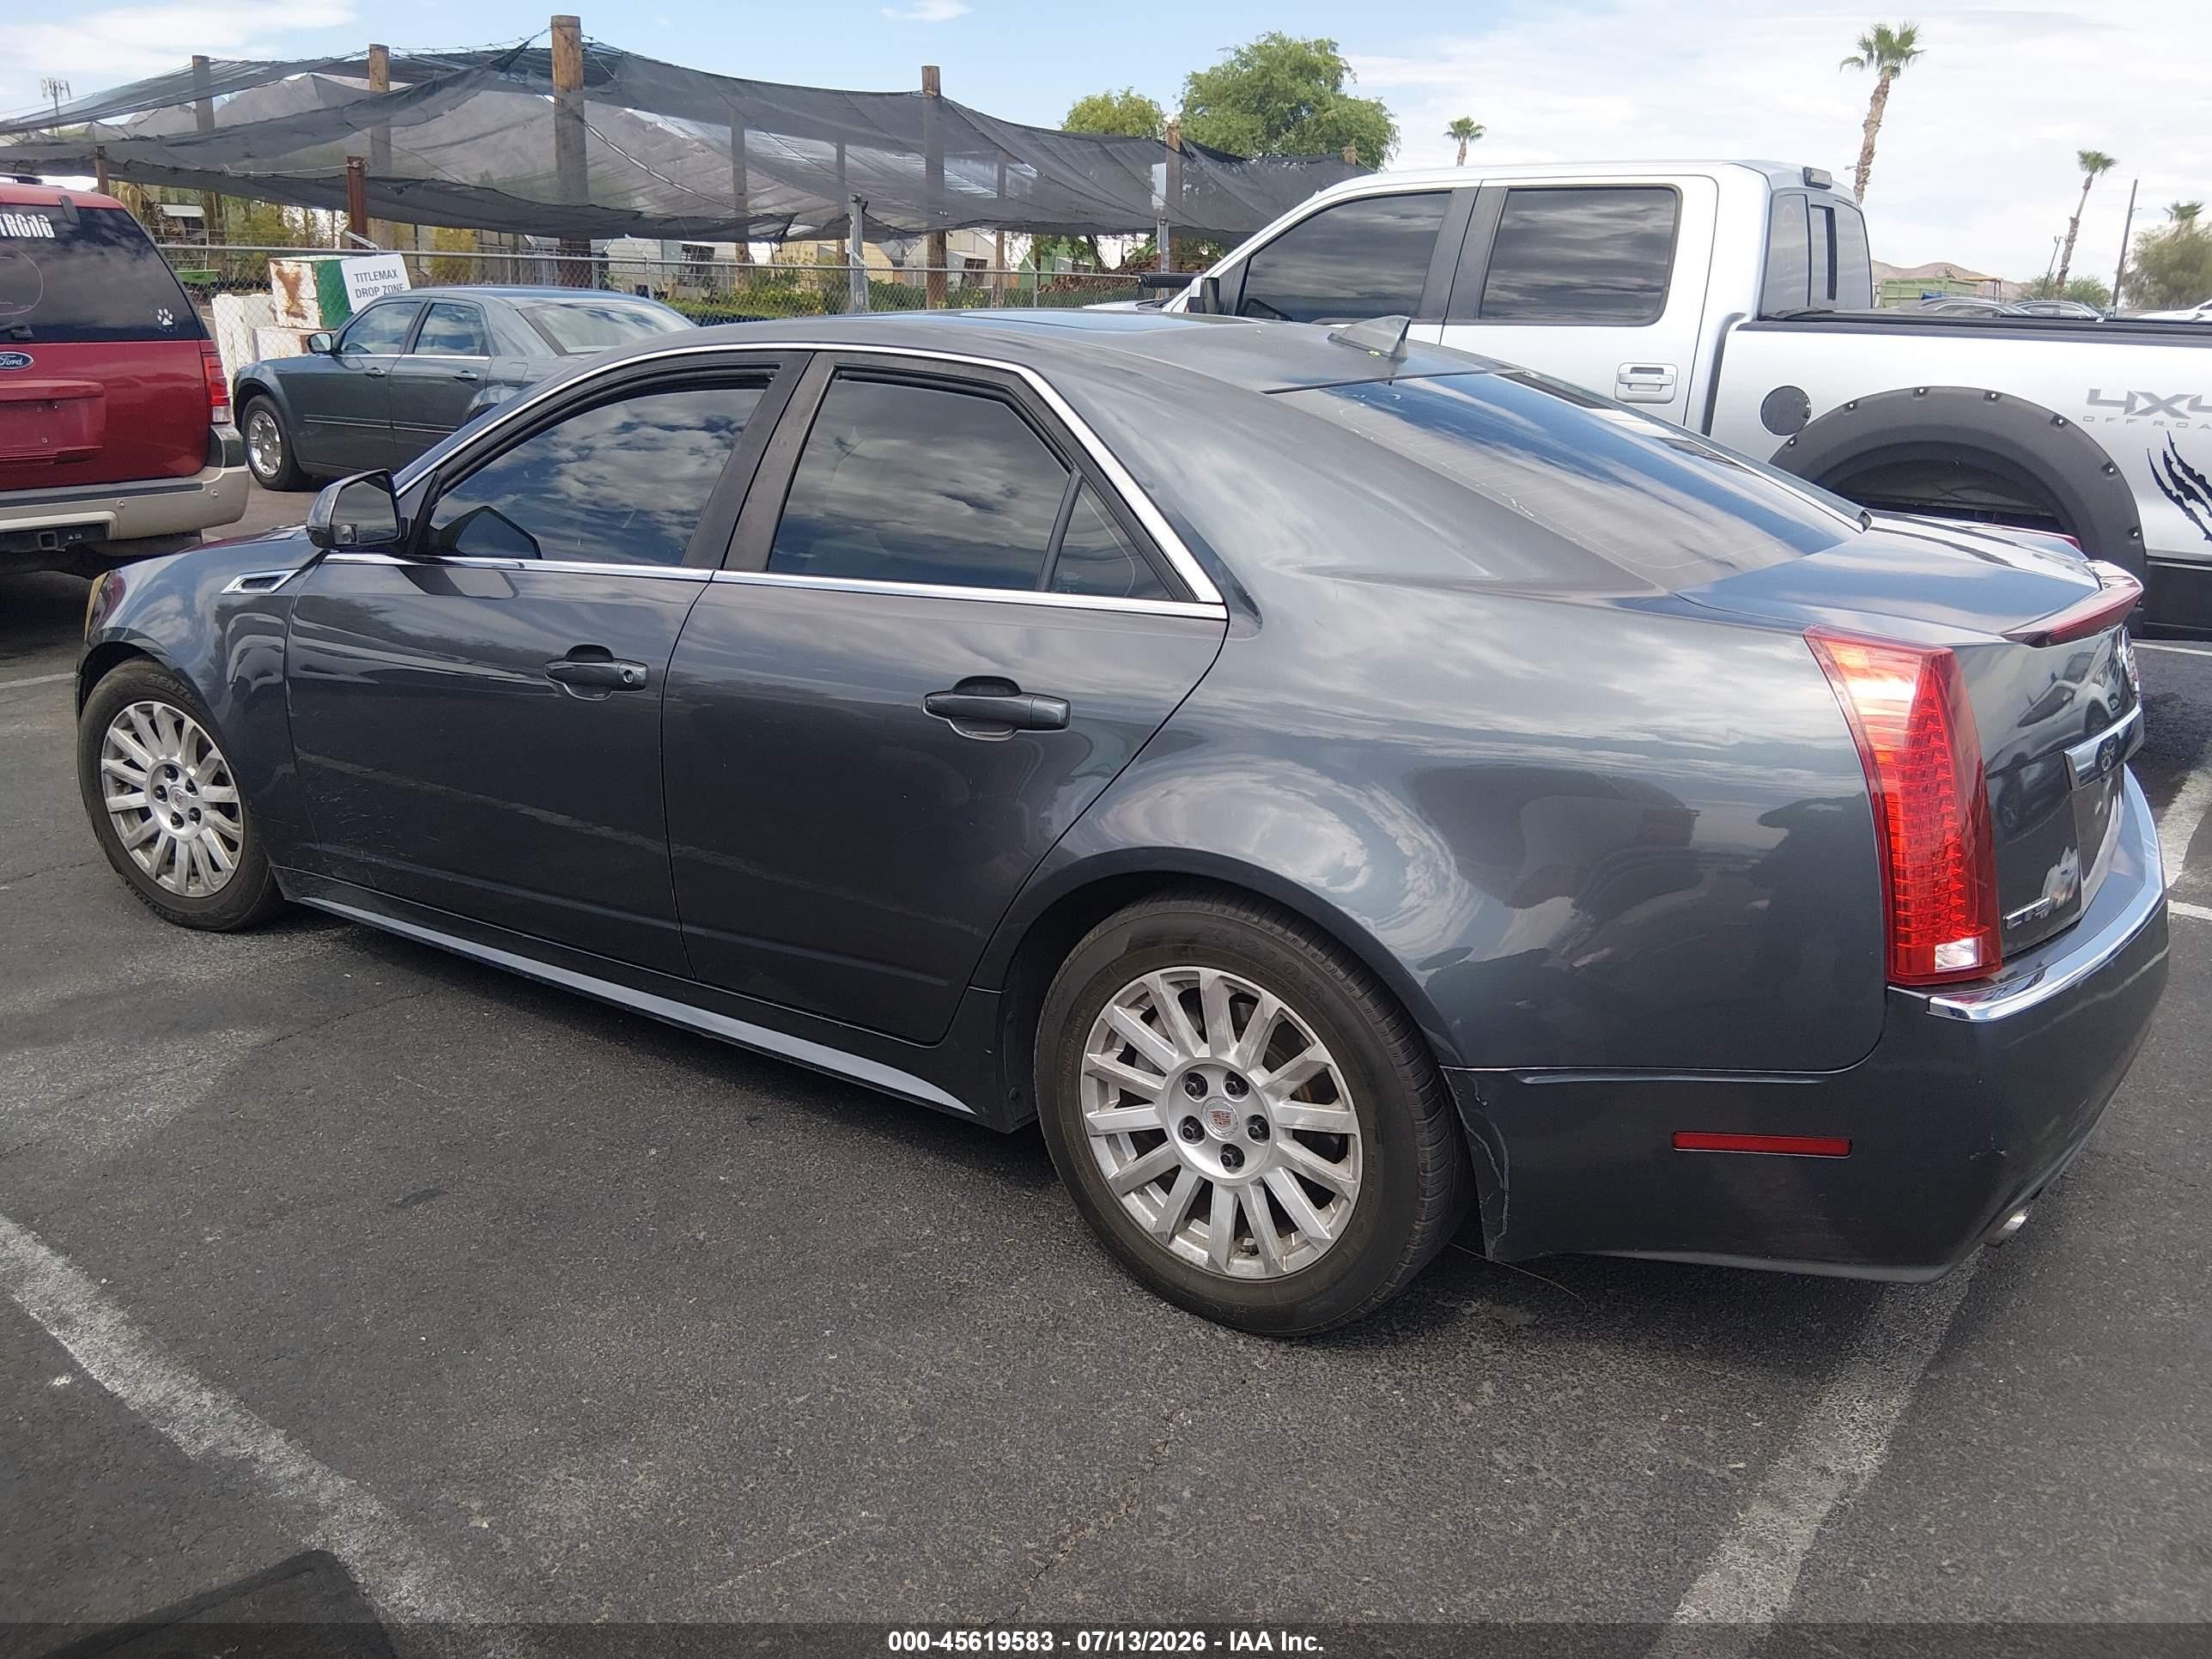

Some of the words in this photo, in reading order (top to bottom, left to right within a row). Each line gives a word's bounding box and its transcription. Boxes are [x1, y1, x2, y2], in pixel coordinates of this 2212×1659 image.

[353, 269, 398, 283] TITLEMAX
[355, 286, 380, 299] DROP
[381, 283, 404, 295] ZONE
[0, 355, 23, 366] Ford
